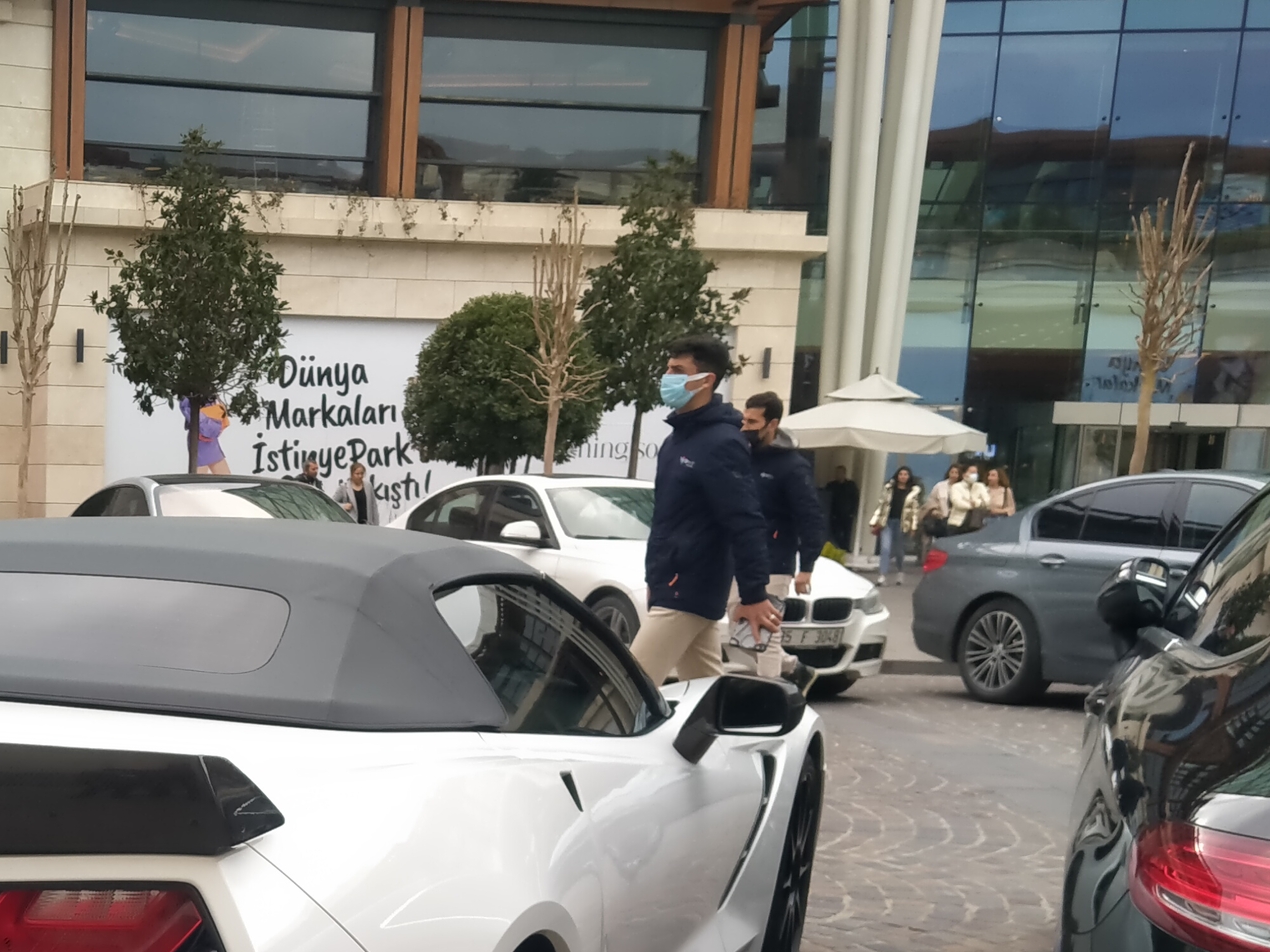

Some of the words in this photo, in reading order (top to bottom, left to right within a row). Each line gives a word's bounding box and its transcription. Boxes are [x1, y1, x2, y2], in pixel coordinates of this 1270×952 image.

[279, 354, 369, 396] Dünya
[266, 393, 397, 430] Markaları
[252, 432, 414, 479] İstinyePark
